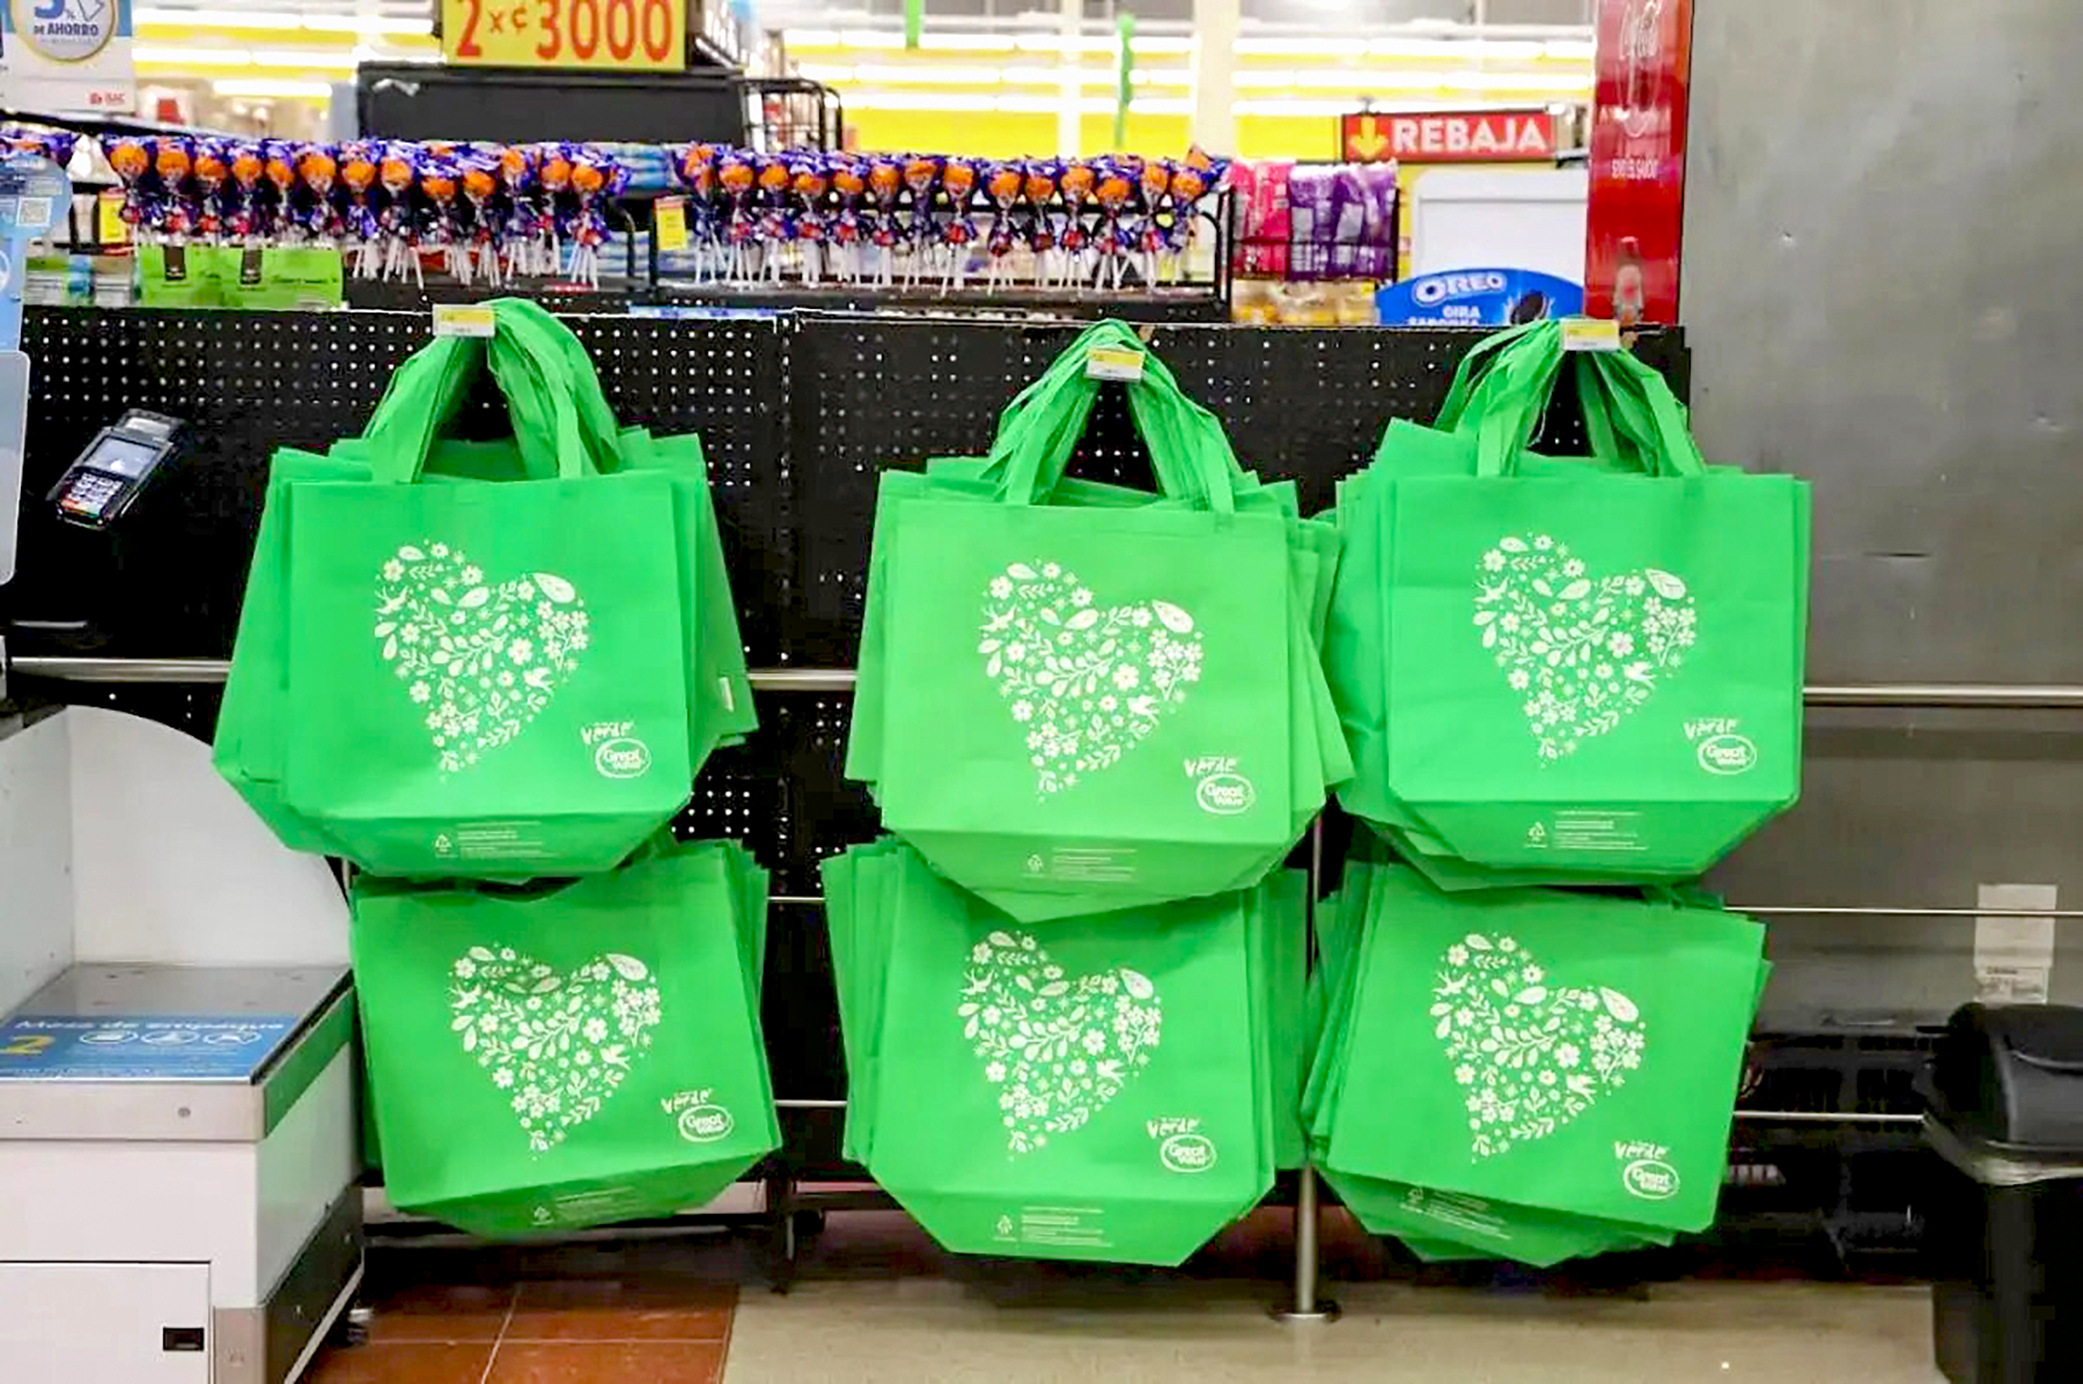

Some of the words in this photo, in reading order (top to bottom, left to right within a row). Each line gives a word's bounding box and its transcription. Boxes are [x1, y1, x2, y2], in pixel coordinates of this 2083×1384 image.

[47, 22, 99, 36] AHORRO
[456, 0, 482, 57] 2
[1392, 118, 1547, 153] REBAJA
[1413, 272, 1507, 306] OREO
